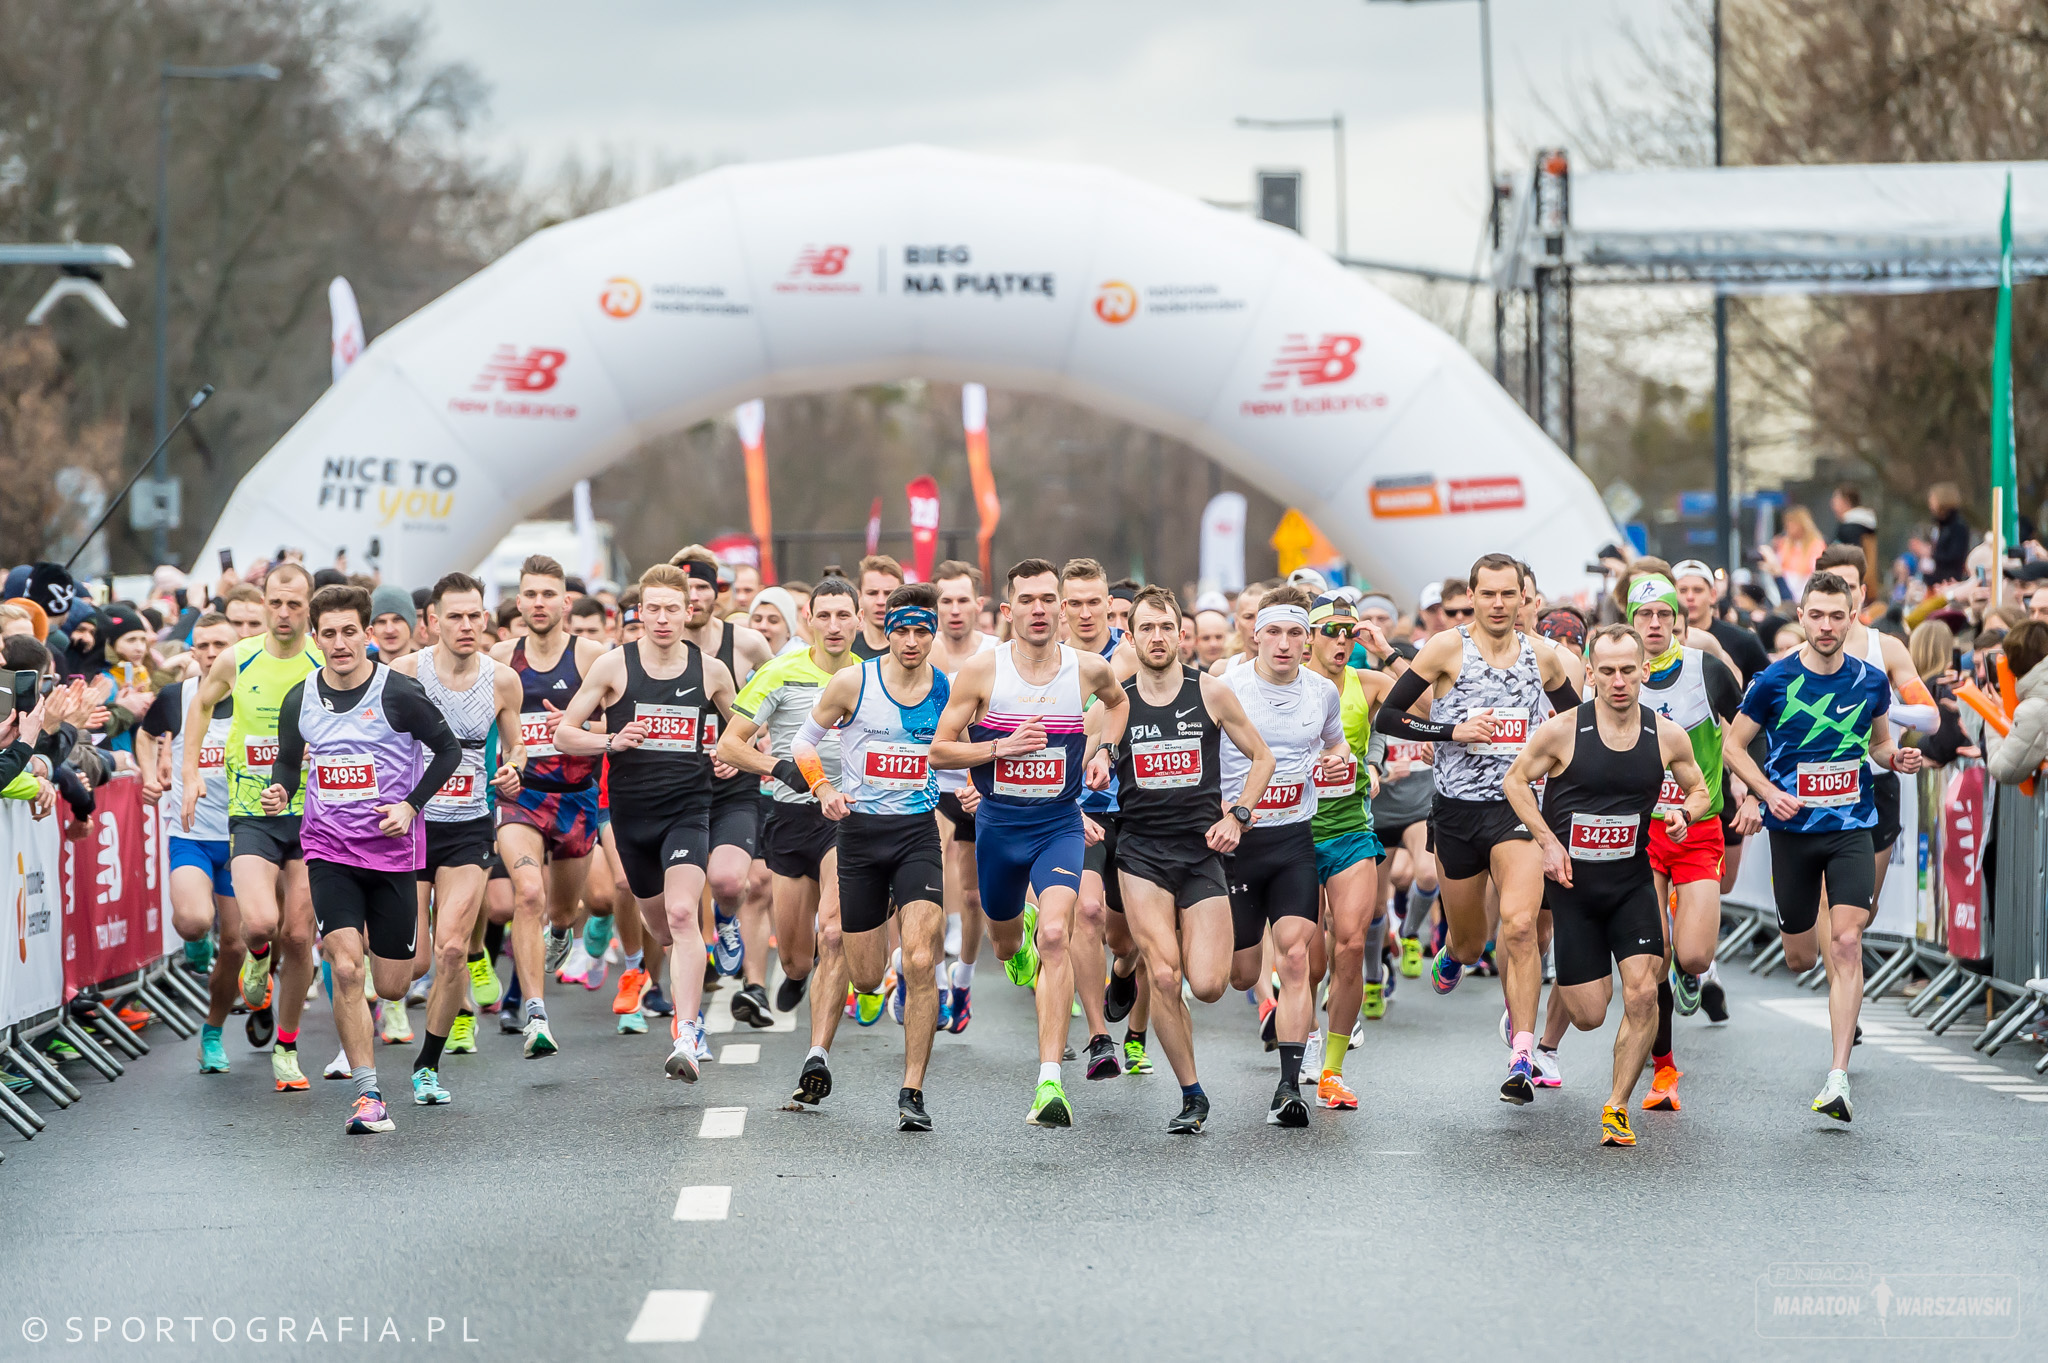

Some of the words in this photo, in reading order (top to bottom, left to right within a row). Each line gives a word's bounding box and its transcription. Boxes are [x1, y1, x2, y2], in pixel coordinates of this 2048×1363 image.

[904, 246, 970, 265] BIEG
[904, 275, 943, 292] NA
[955, 274, 1054, 300] PIĄTKĘ
[323, 456, 398, 485] NICE
[411, 459, 457, 489] TO
[318, 484, 366, 509] FIT
[378, 488, 454, 526] you
[521, 724, 553, 741] 342
[646, 716, 689, 735] 33852
[863, 727, 890, 740] GARMIN
[1410, 719, 1430, 730] ROYAL
[876, 755, 920, 774] 31121
[1004, 761, 1056, 779] 34384
[1143, 752, 1192, 772] 34198
[323, 766, 367, 785] 34955
[1807, 772, 1852, 792] 31050
[1580, 827, 1630, 843] 34233
